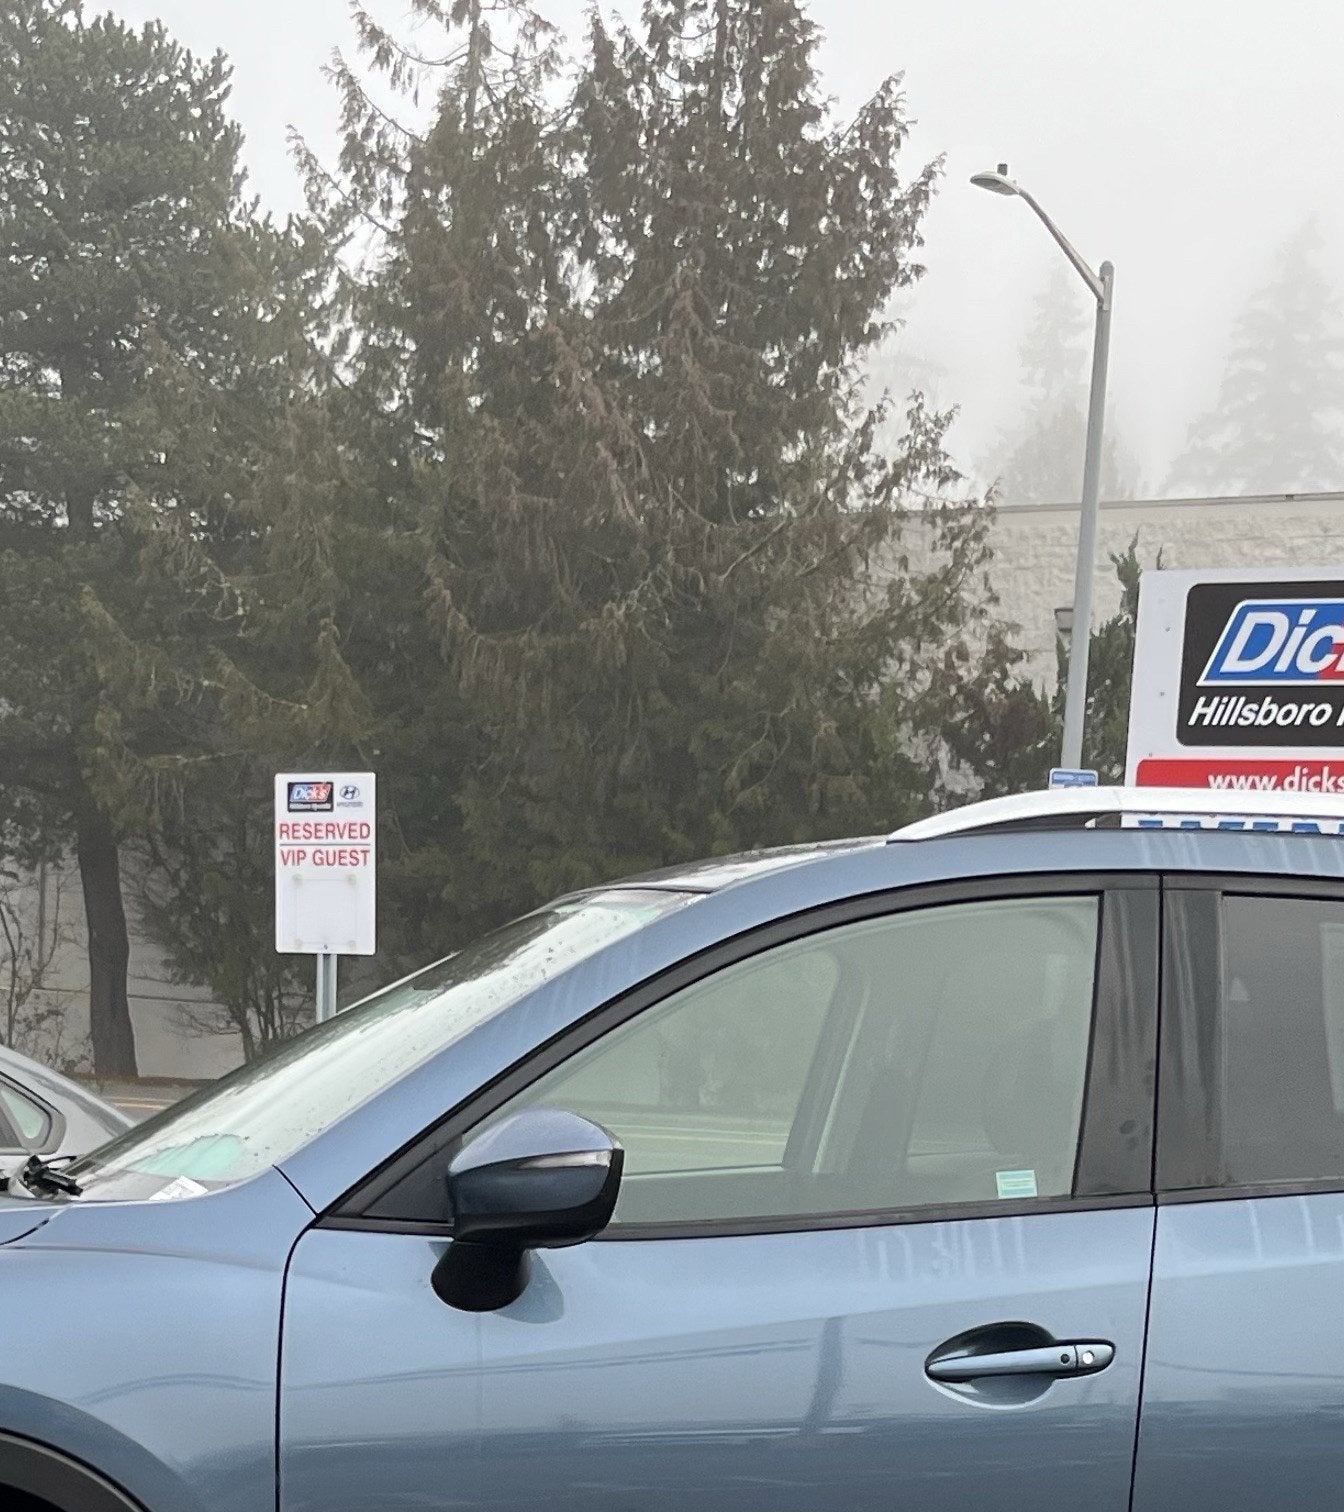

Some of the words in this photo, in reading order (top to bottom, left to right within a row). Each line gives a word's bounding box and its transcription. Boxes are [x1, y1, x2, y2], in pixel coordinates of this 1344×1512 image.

[1187, 696, 1333, 727] Hillsboro
[279, 822, 371, 840] RESERVED
[280, 849, 307, 866] VIP
[312, 849, 371, 867] GUEST
